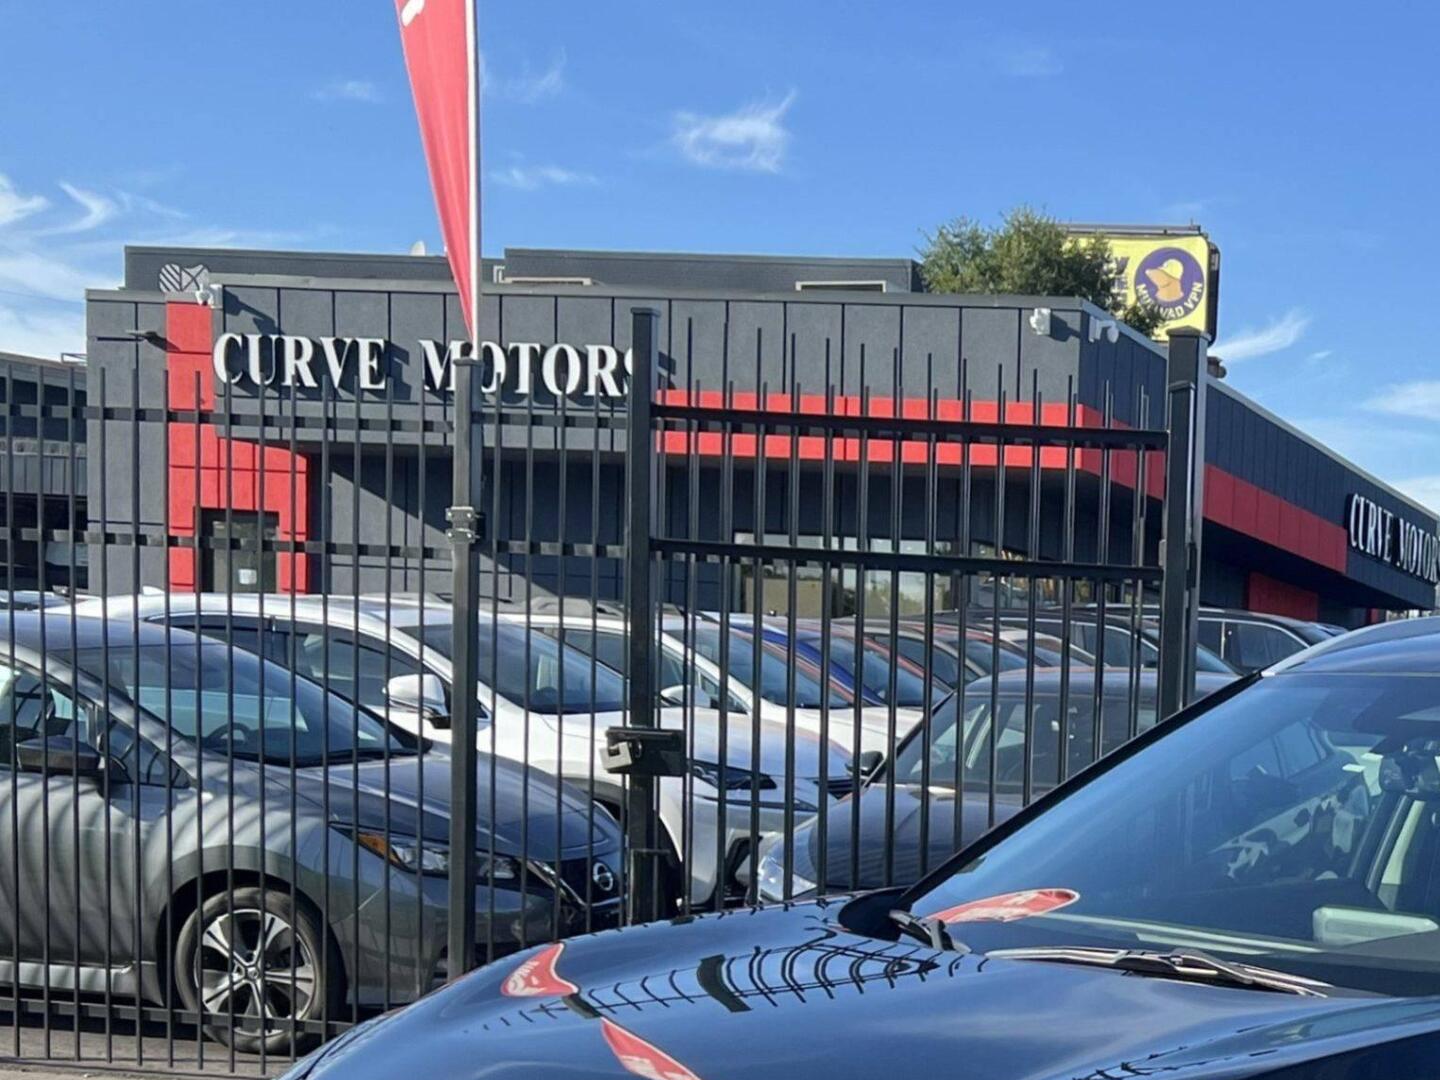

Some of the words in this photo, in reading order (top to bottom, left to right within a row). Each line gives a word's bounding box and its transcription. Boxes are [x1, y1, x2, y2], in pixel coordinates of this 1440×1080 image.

[1183, 281, 1203, 310] VPN
[213, 332, 386, 391] CURVE
[1350, 493, 1394, 563] CURVE
